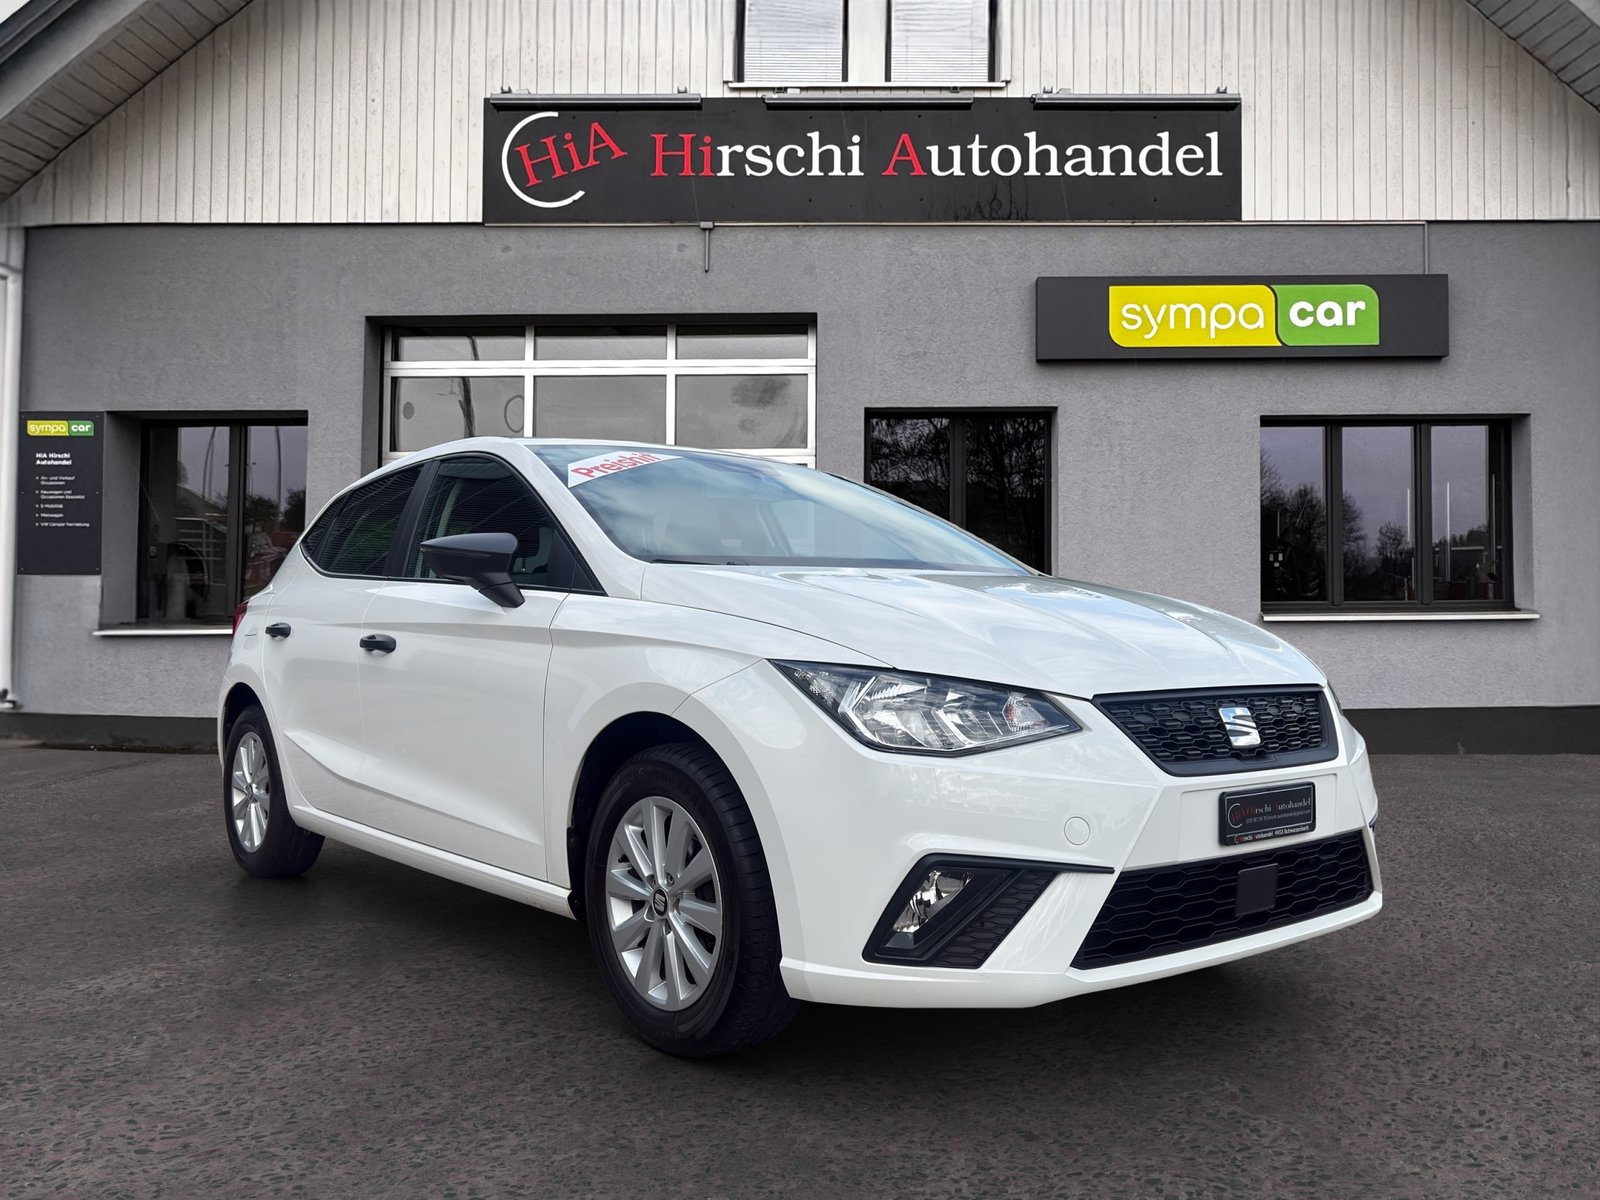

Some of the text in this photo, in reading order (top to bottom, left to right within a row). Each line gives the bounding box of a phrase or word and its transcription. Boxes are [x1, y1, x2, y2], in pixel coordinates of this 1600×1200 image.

[515, 121, 1223, 188] HiA Hirschi Autohandel
[1121, 299, 1366, 339] sympa car
[30, 424, 91, 433] sympa car
